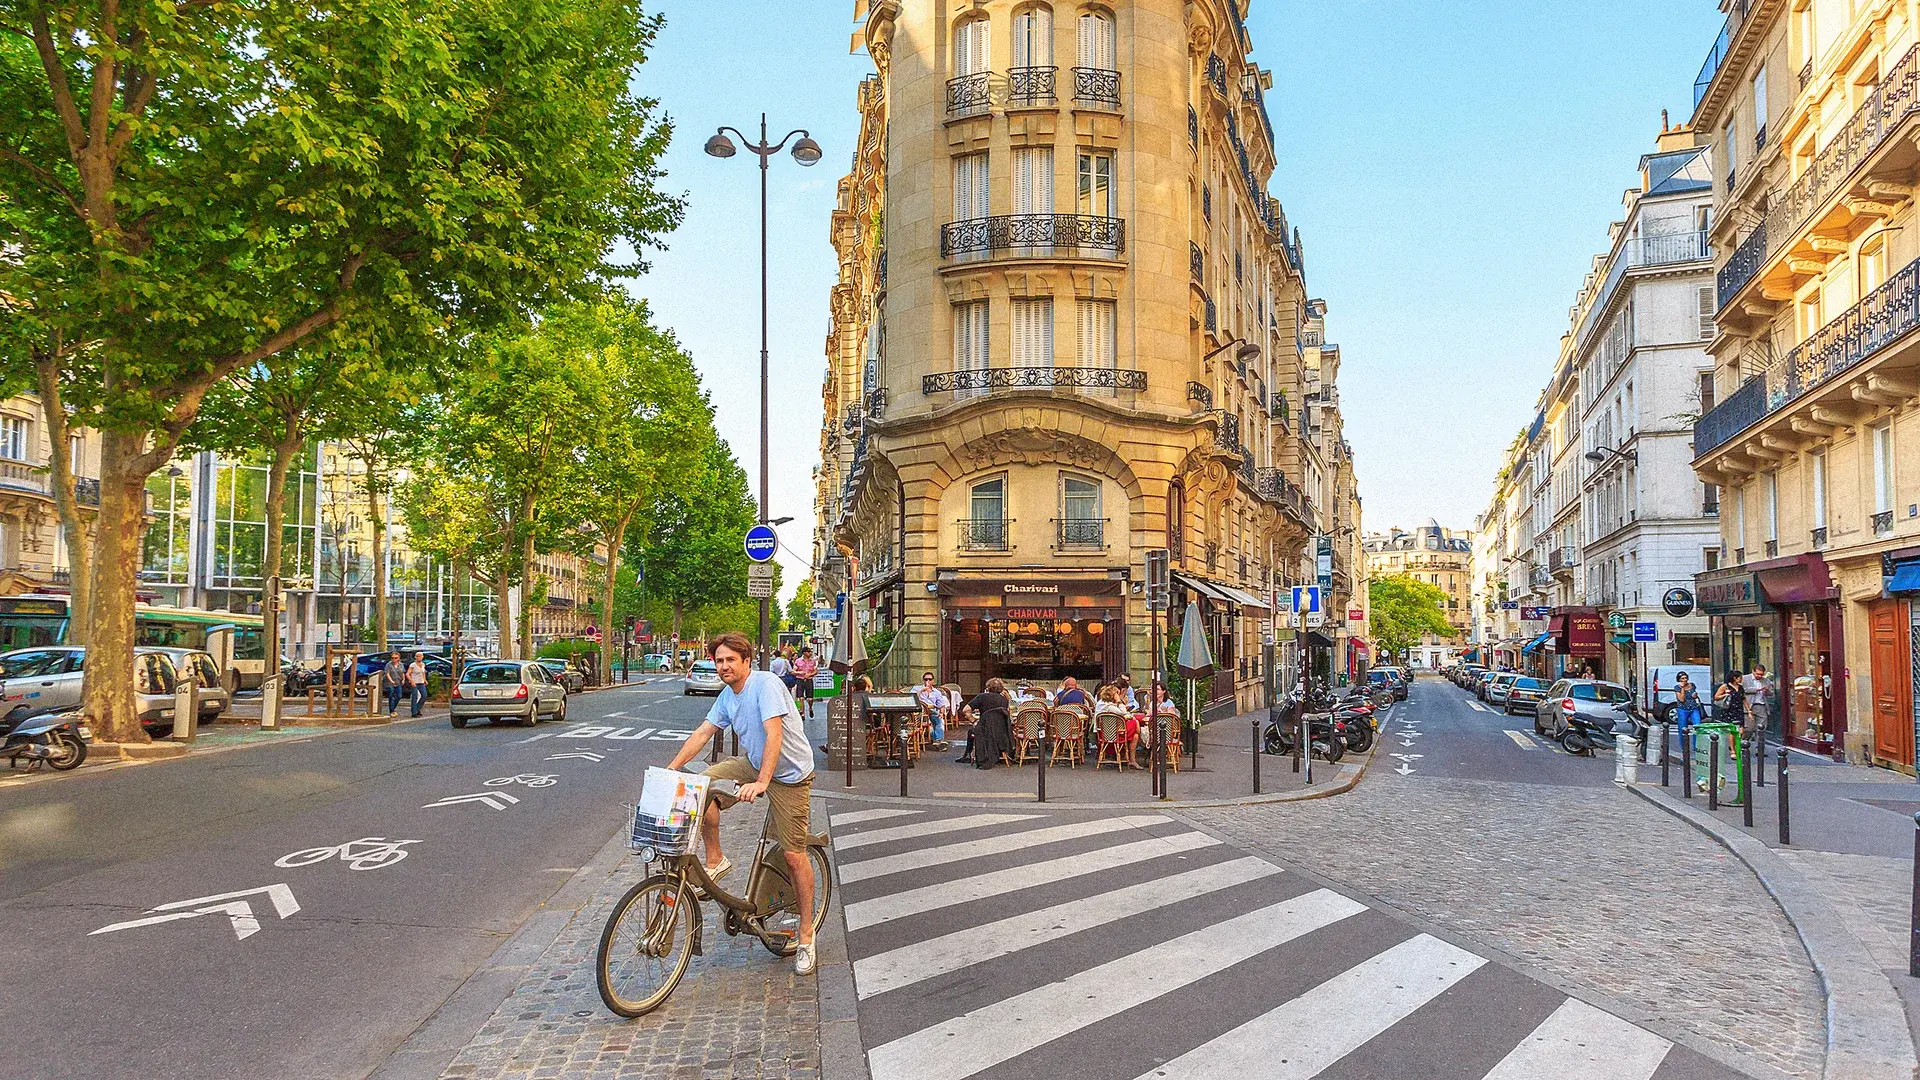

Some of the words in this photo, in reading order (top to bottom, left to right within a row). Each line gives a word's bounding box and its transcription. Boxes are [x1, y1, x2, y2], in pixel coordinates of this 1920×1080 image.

[1003, 584, 1059, 593] Charivari
[1007, 609, 1057, 618] CHARIVARI
[177, 686, 189, 695] 04
[265, 682, 276, 690] 03
[556, 726, 695, 741] BUS
